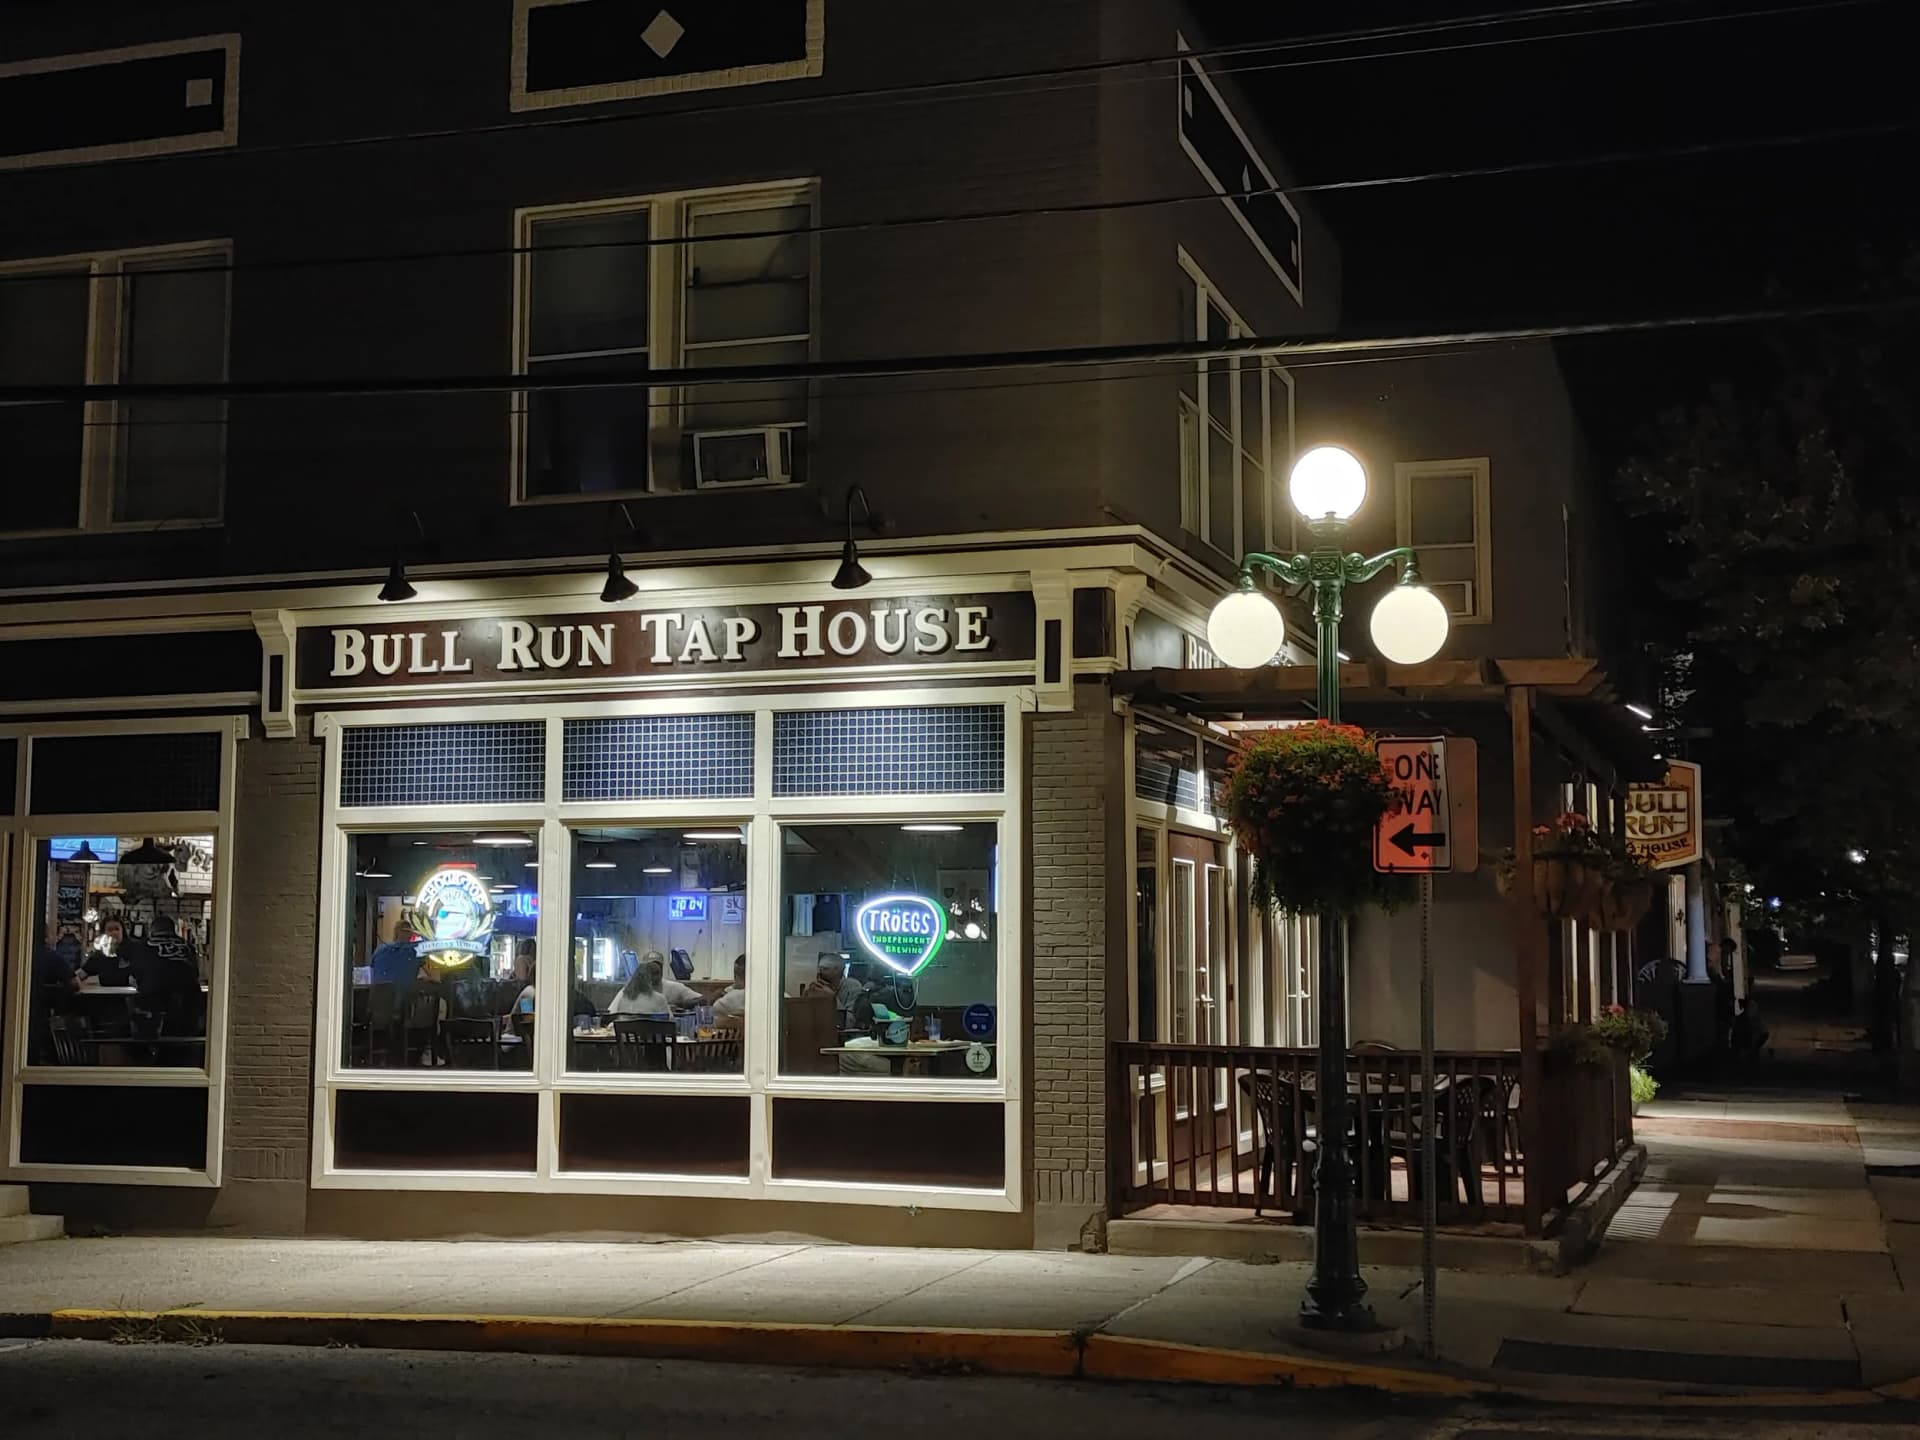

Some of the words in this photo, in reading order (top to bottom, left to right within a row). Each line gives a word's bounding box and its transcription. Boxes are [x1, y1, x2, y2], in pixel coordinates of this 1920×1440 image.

[330, 628, 472, 677] BULL
[497, 620, 615, 670] RUN
[640, 612, 757, 663] TAP
[777, 605, 991, 658] HOUSE
[1394, 754, 1441, 780] ONE
[872, 935, 931, 945] INDEPENDENT
[886, 945, 923, 954] BREWING
